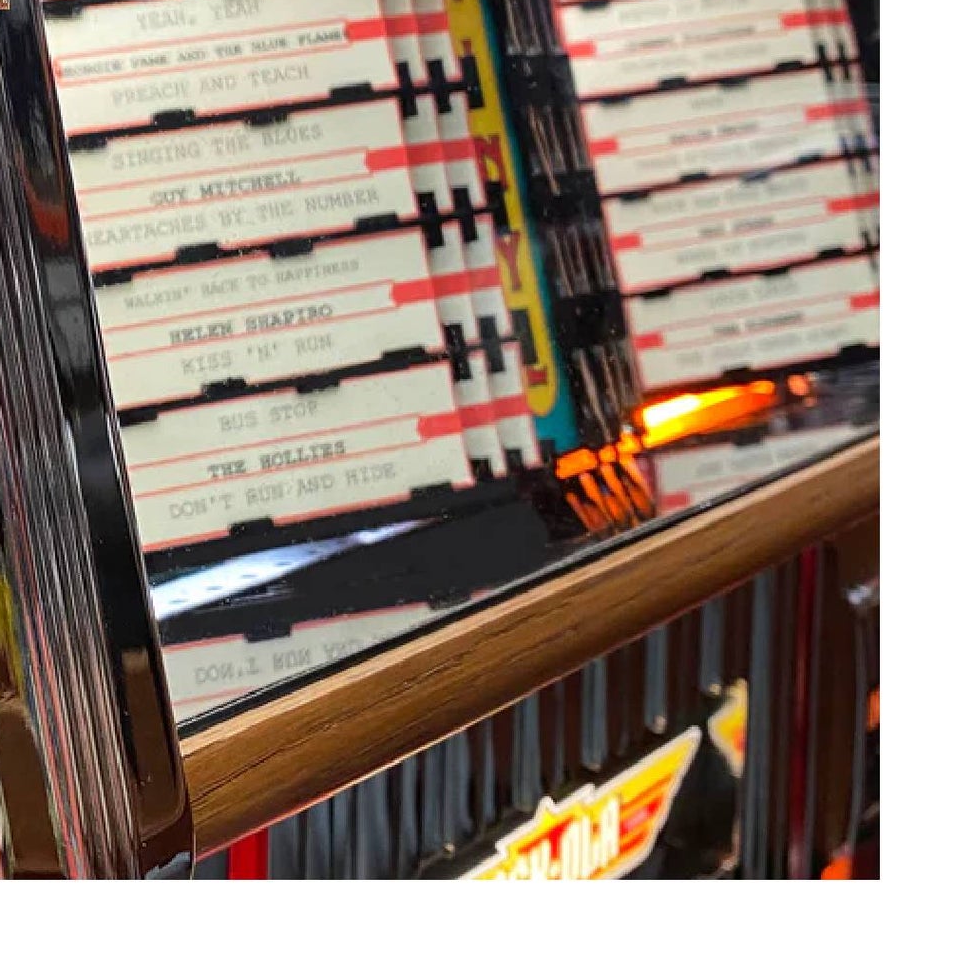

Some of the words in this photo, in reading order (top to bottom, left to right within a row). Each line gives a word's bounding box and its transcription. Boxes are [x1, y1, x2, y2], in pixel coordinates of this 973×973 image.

[210, 0, 259, 22] YEAH
[130, 53, 168, 69] FAME
[177, 49, 207, 64] AND
[215, 44, 243, 59] THE
[111, 80, 187, 105] PREACH
[199, 72, 238, 94] AND
[247, 64, 310, 88] TEACH
[111, 144, 202, 169] SINGING
[212, 134, 249, 156] THE
[261, 125, 324, 146] BLUES
[149, 188, 188, 207] GUY
[196, 172, 303, 199] MITCHELL
[219, 204, 246, 225] BY
[258, 197, 295, 219] THE
[304, 188, 379, 213] NUMBER
[122, 286, 190, 311] WALKIN'
[201, 278, 240, 300] BACK
[246, 273, 270, 292] TO
[276, 258, 360, 288] HAPPINESS
[169, 322, 233, 344] HELEN
[245, 304, 333, 332] SHAPIRO
[182, 353, 233, 375] KISS
[296, 334, 333, 356] RUN
[217, 412, 258, 432] BUS
[269, 400, 319, 424] STOP
[208, 458, 247, 479] THE
[259, 439, 347, 470] HOLLIES
[168, 494, 233, 520] DON'T
[245, 483, 286, 506] RUN
[295, 473, 336, 496] AND
[346, 463, 397, 486] HIDE
